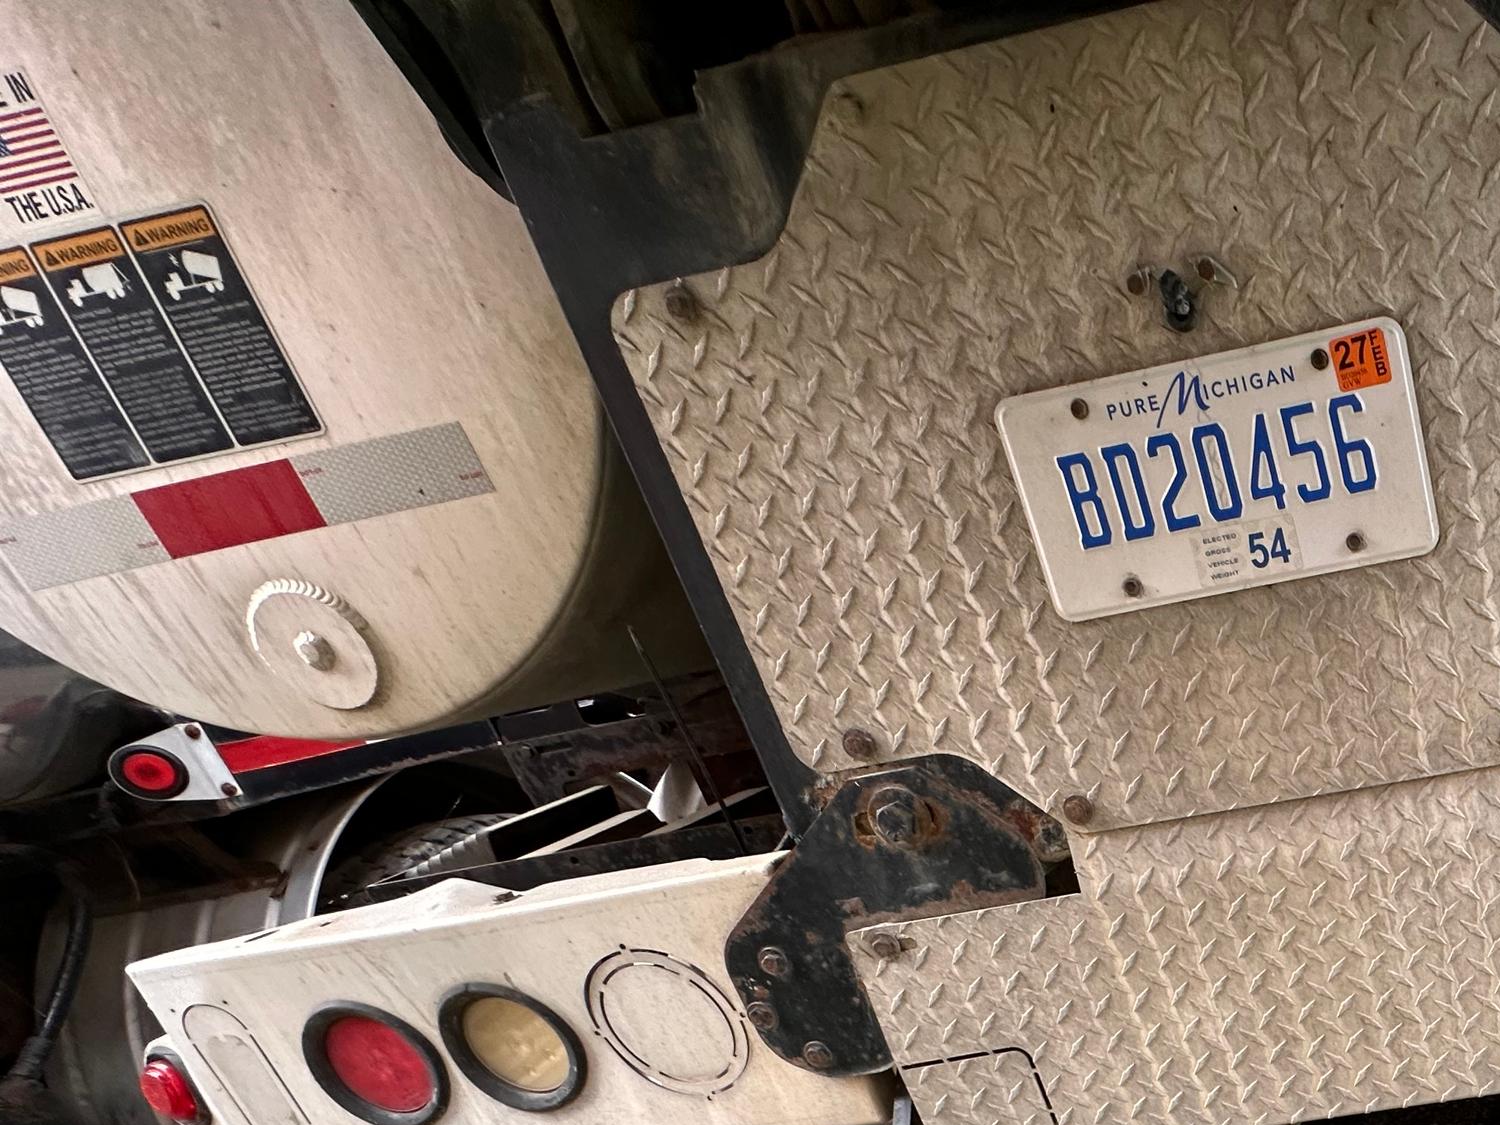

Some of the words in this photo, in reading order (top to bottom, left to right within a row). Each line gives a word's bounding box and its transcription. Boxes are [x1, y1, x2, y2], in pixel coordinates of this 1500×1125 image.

[4, 72, 35, 103] IN
[4, 192, 48, 223] THE
[41, 183, 95, 216] U.S.A.
[144, 218, 209, 243] WARNING
[56, 238, 118, 263] WARNING
[1334, 334, 1367, 370] 27
[1368, 329, 1388, 377] FEB
[1106, 394, 1161, 421] PURE
[1156, 365, 1296, 429] MICHIGAN
[1056, 394, 1377, 549] BD20456
[1202, 532, 1237, 545] ELECTED
[1205, 547, 1231, 557] GROSS
[1248, 527, 1292, 569] 54
[1207, 557, 1239, 569] VEHICLE
[1210, 570, 1240, 581] WEIGHT
